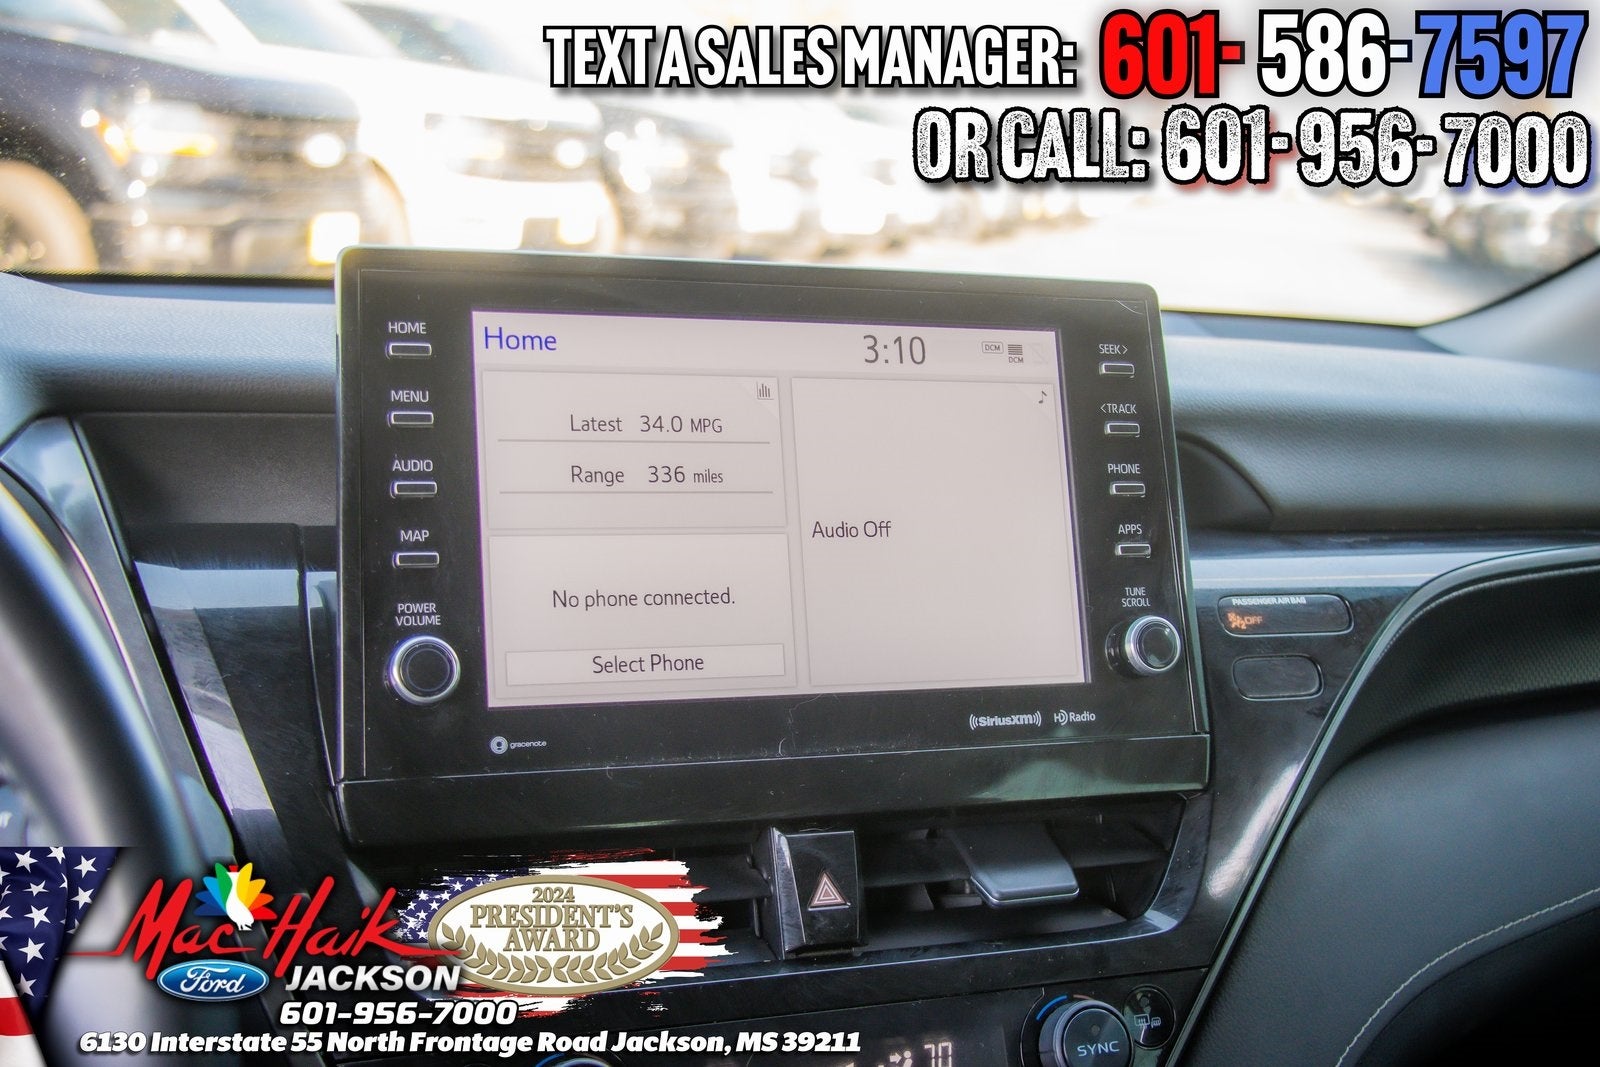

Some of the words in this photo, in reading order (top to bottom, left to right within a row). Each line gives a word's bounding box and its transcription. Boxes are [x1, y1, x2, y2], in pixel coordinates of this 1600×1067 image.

[388, 322, 427, 334] HOME
[484, 326, 557, 351] Home
[863, 335, 927, 365] 3:10
[984, 341, 1001, 352] DCM
[1098, 343, 1121, 355] SEEK
[1008, 356, 1024, 364] DCM
[390, 390, 429, 402] MENU
[570, 413, 623, 432] Latest
[639, 415, 683, 433] 34.0
[690, 419, 723, 433] MPG
[392, 459, 433, 472] AUDIO
[1107, 463, 1141, 475] PHONE
[570, 465, 625, 487] Range
[648, 466, 686, 484] 336
[693, 470, 724, 484] miles
[811, 521, 859, 538] Audio
[863, 520, 892, 538] Off
[1117, 523, 1143, 535] APPS
[400, 530, 430, 542] MAP
[1125, 587, 1146, 596] TUNE
[552, 590, 579, 608] No
[585, 589, 638, 611] phone
[643, 587, 736, 606] connected.
[1121, 597, 1151, 607] SCROLL
[397, 603, 437, 614] POWER
[395, 615, 441, 626] VOLUME
[1244, 616, 1262, 625] OFF
[592, 655, 645, 673] Select
[650, 653, 705, 671] Phone
[1069, 710, 1096, 722] Radio
[510, 740, 547, 749] gracenote
[1077, 1040, 1120, 1056] SYNC
